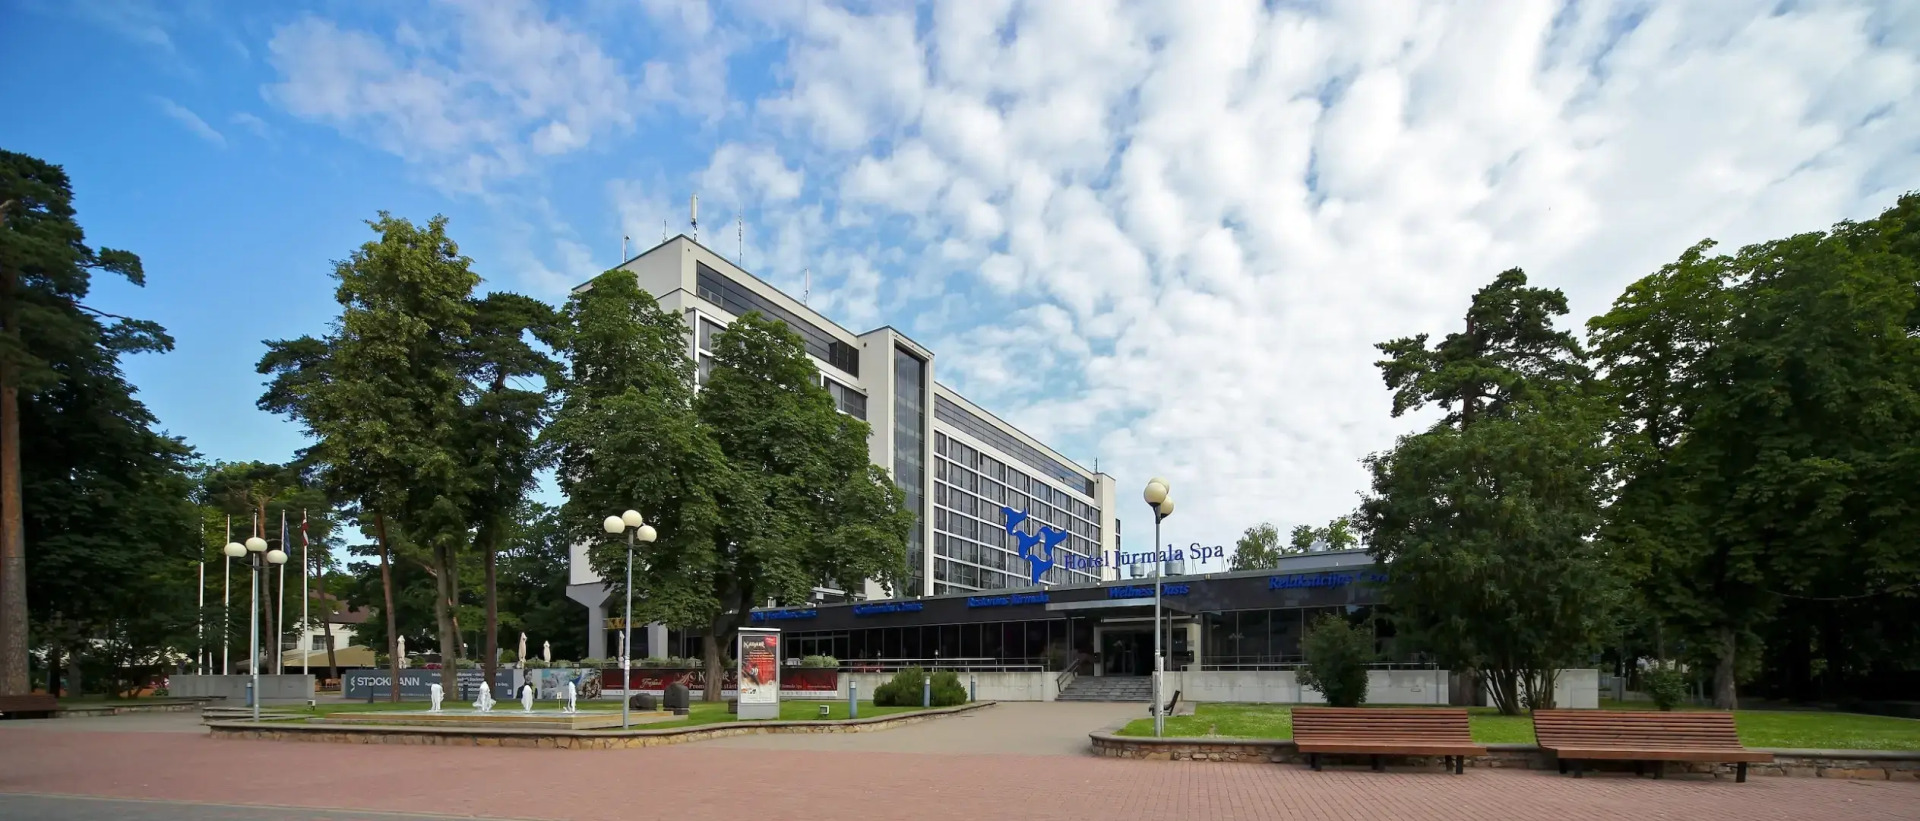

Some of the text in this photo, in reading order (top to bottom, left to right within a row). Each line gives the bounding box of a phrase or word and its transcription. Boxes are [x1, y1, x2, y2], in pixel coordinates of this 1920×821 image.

[1064, 550, 1110, 571] Hotel
[1190, 542, 1224, 564] Spa
[1109, 584, 1154, 599] Wellness
[357, 676, 420, 686] STOCKANN
